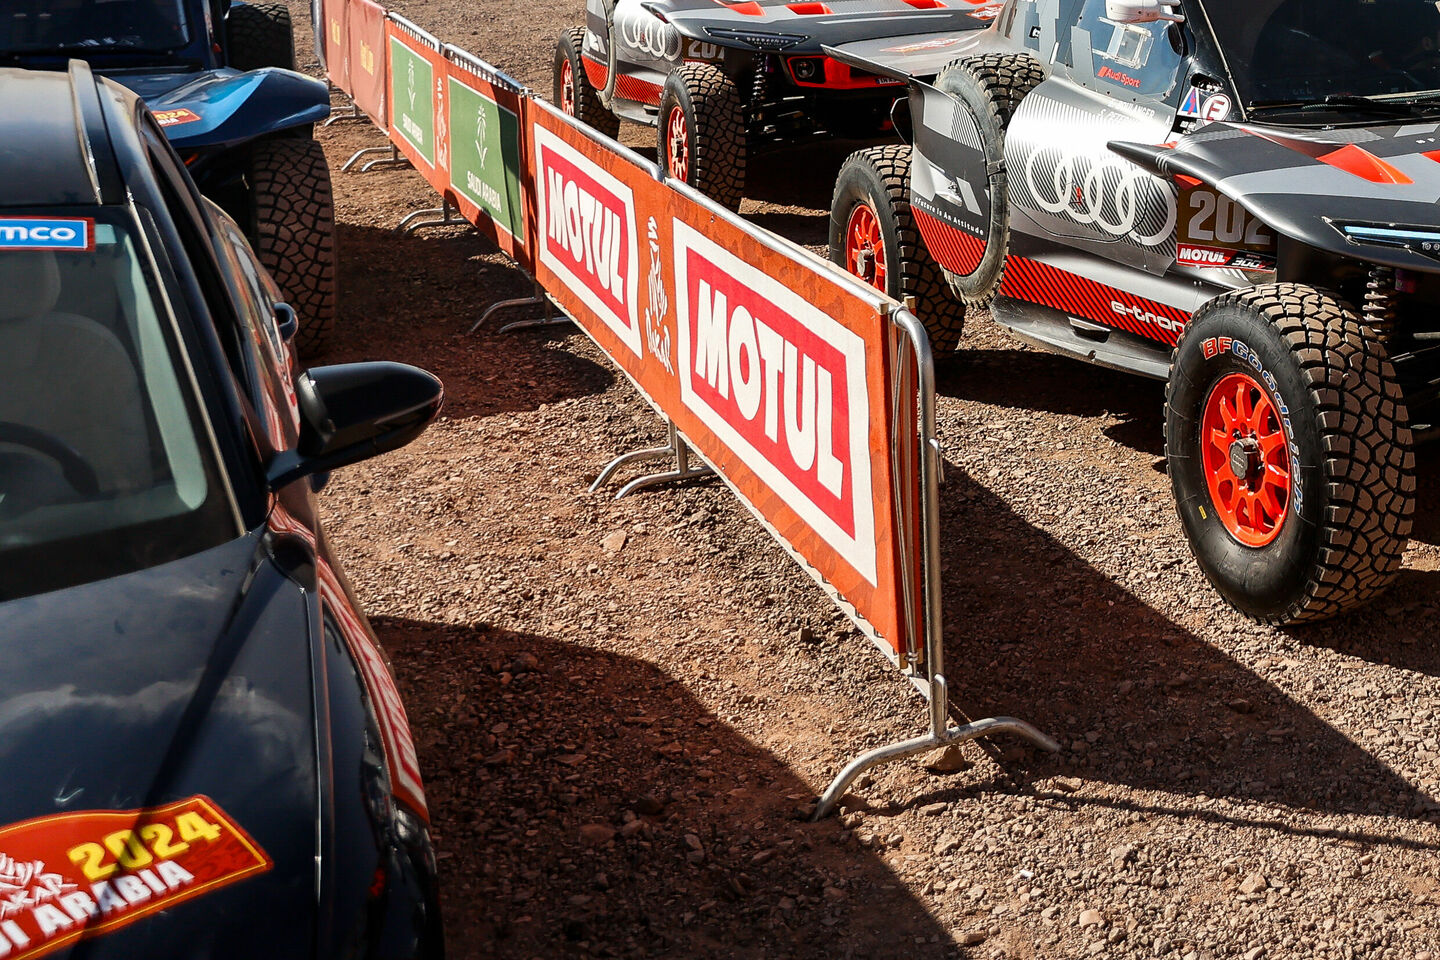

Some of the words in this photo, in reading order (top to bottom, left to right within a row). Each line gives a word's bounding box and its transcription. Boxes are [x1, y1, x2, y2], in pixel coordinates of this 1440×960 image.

[1106, 68, 1122, 83] Audi
[1120, 73, 1142, 88] Sport
[1206, 100, 1225, 121] E
[467, 170, 482, 198] SAUDI
[481, 181, 502, 214] ARABIA
[0, 226, 77, 241] mco
[547, 165, 627, 306] MOTUL
[943, 211, 952, 222] An
[953, 214, 984, 236] Attitude
[1179, 248, 1227, 263] MOTUL
[1110, 299, 1185, 334] e-tron
[695, 278, 845, 500] MOTUL
[66, 810, 222, 883] 2024
[32, 859, 196, 936] ARABIA
